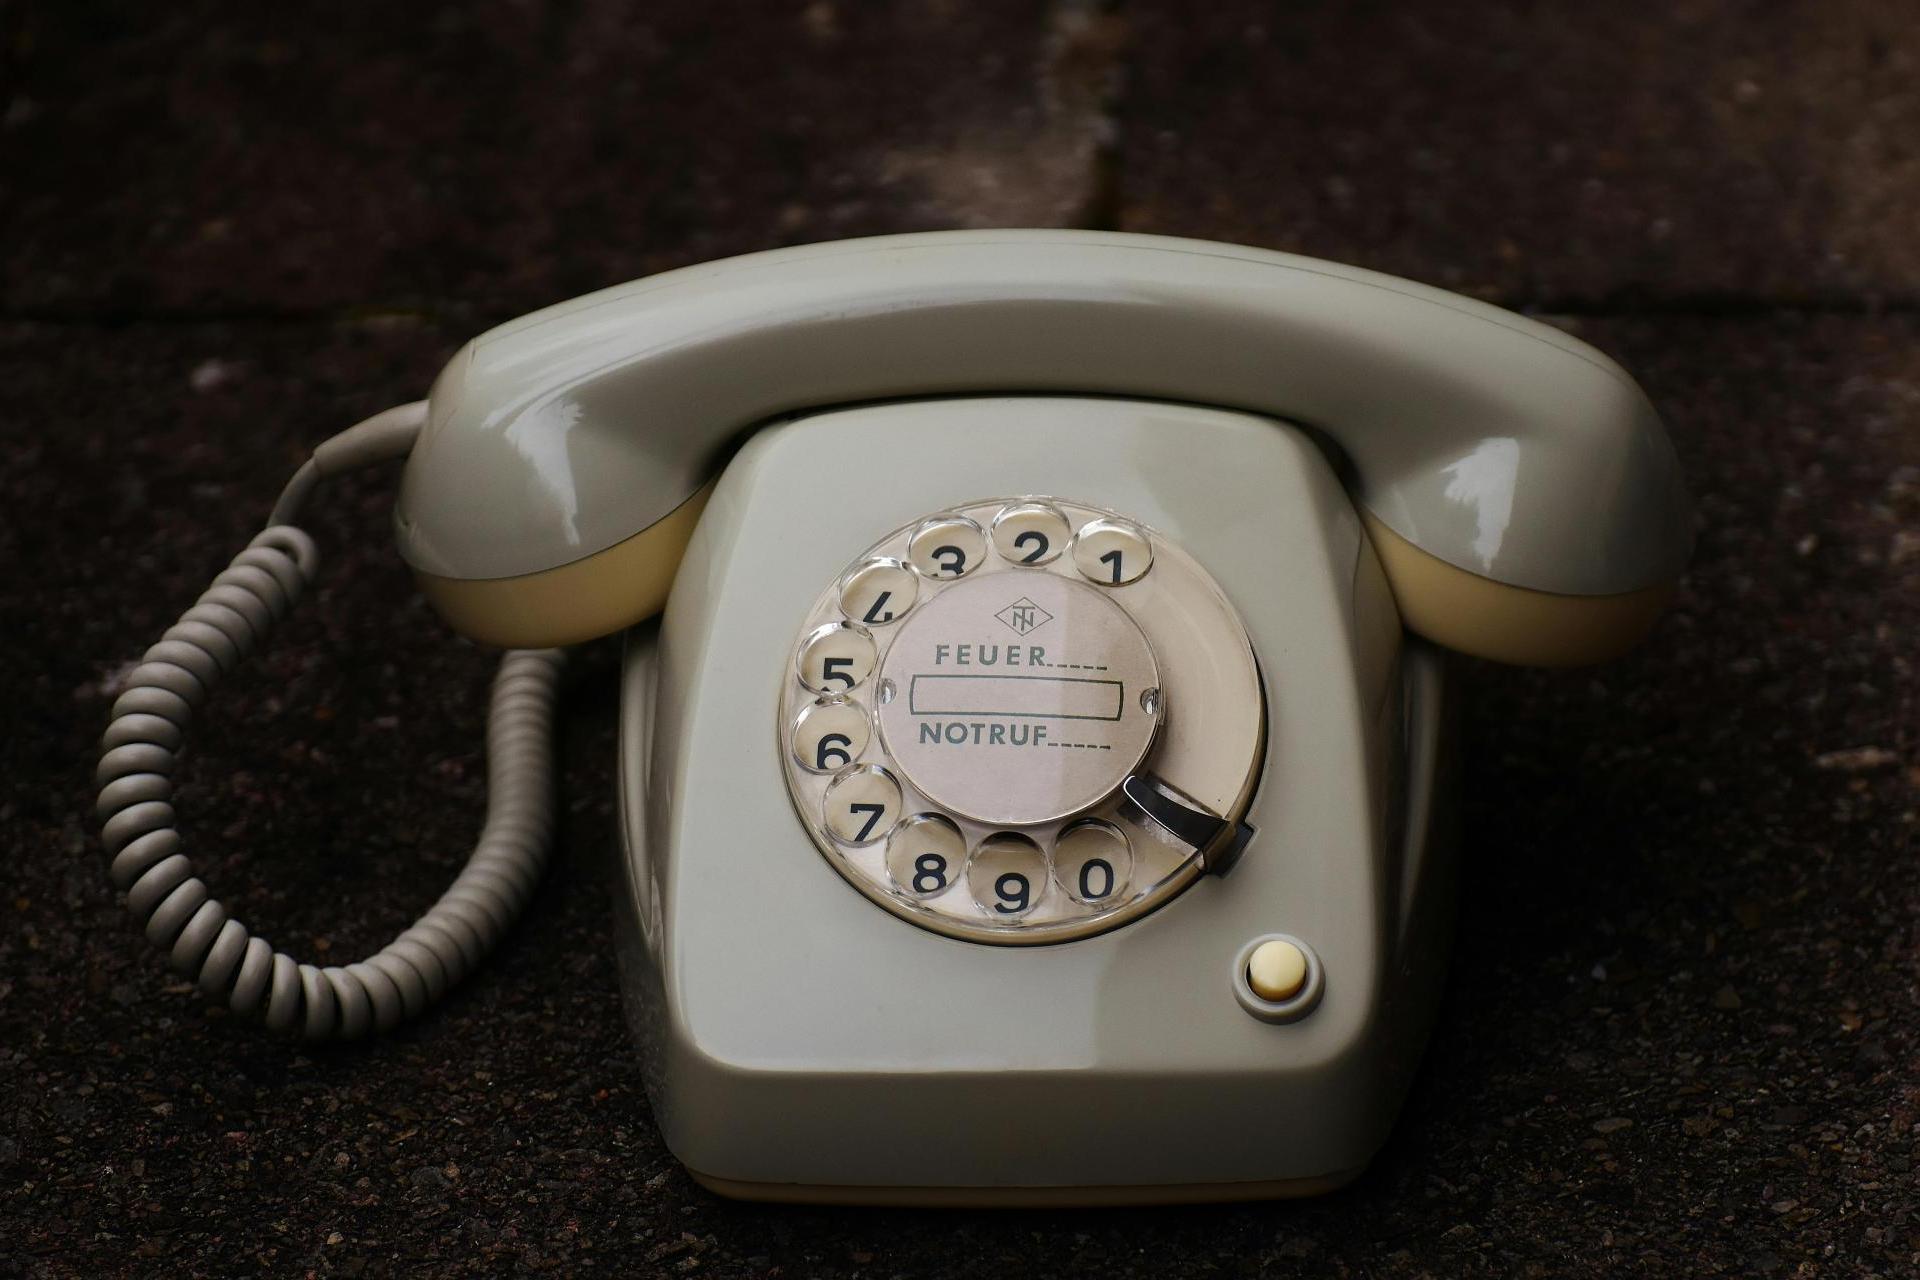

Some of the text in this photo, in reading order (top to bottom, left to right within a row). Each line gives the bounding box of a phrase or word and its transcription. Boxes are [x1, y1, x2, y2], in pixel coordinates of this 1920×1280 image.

[931, 545, 966, 577] 3
[1014, 531, 1049, 563] 2
[1100, 550, 1122, 583] 1
[935, 644, 1046, 666] FEUER
[823, 657, 856, 691] 5
[816, 733, 852, 769] 6
[919, 722, 1047, 746] NOTRUF
[850, 803, 885, 842] 7
[912, 853, 947, 893] 8
[1079, 858, 1114, 899] 0
[994, 872, 1030, 913] 9
